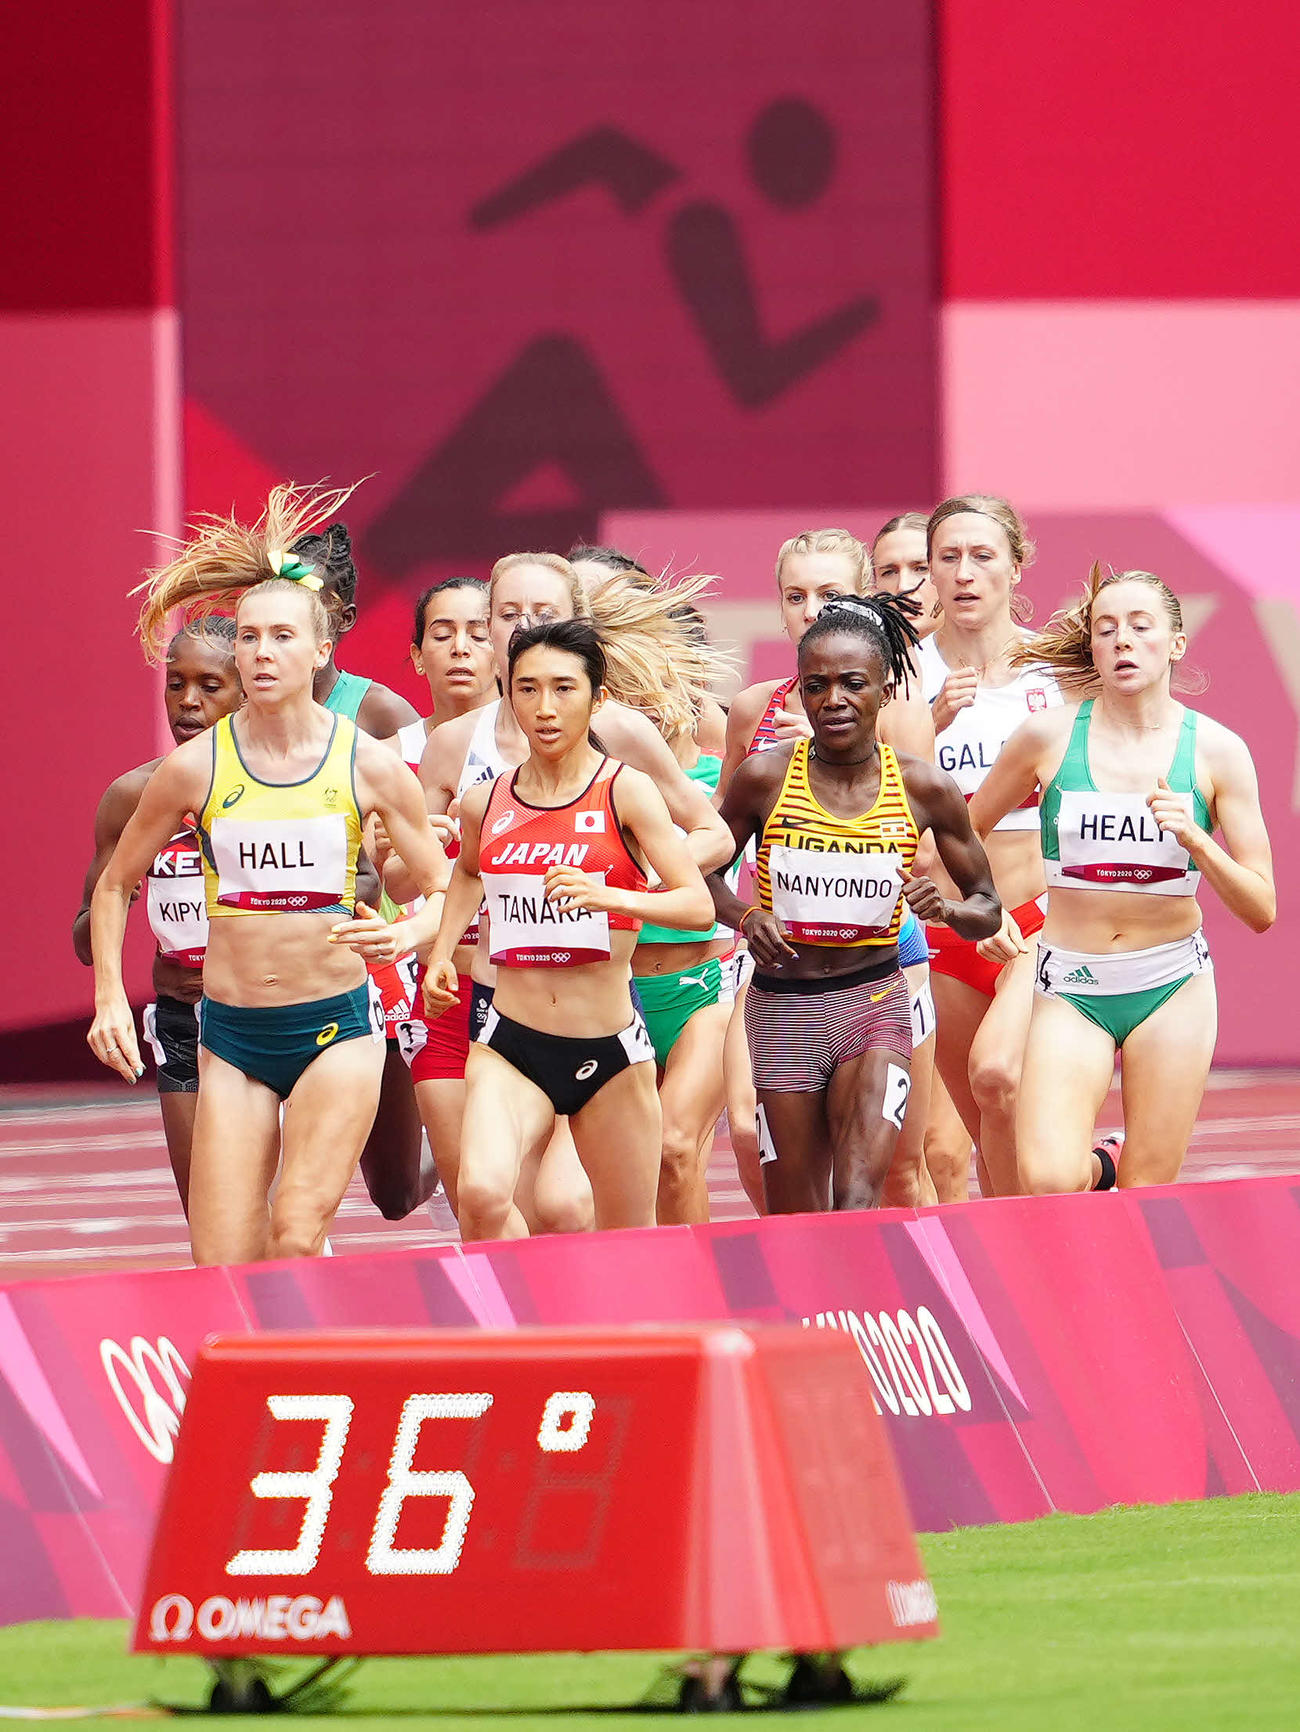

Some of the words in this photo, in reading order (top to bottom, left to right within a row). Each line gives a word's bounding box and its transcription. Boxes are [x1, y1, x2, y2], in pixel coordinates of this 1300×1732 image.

[940, 741, 1007, 771] GAL
[239, 841, 314, 869] HALL
[491, 842, 590, 866] JAPAN
[1096, 869, 1117, 877] TOKYO
[777, 871, 892, 898] NANYONDO
[250, 897, 270, 905] TOKYO
[160, 902, 208, 922] KIPY
[802, 928, 822, 936] TOKYO
[516, 954, 535, 962] TOKYO
[536, 954, 550, 962] 2020
[1063, 975, 1099, 986] adidas
[196, 1594, 352, 1642] OMEGA
